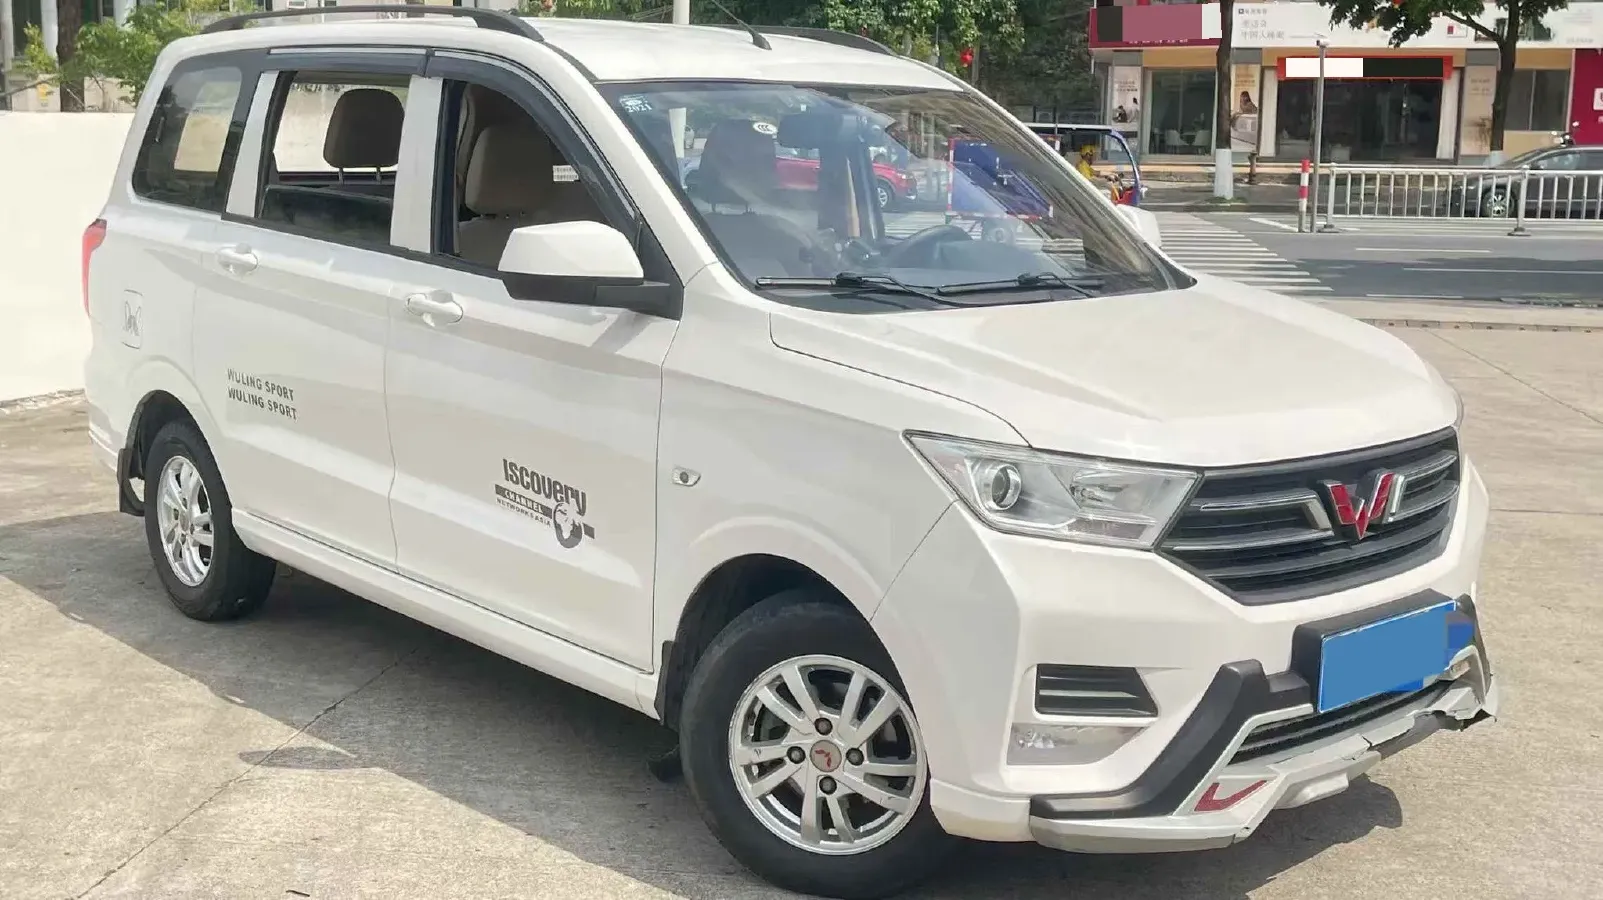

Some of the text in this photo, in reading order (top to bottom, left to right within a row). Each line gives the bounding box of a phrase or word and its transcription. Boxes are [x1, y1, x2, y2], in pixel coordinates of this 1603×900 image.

[624, 103, 653, 113] 2021
[227, 367, 294, 401] WULING SPORT
[227, 387, 297, 420] WULING SPORT
[504, 489, 544, 516] CHANNEL
